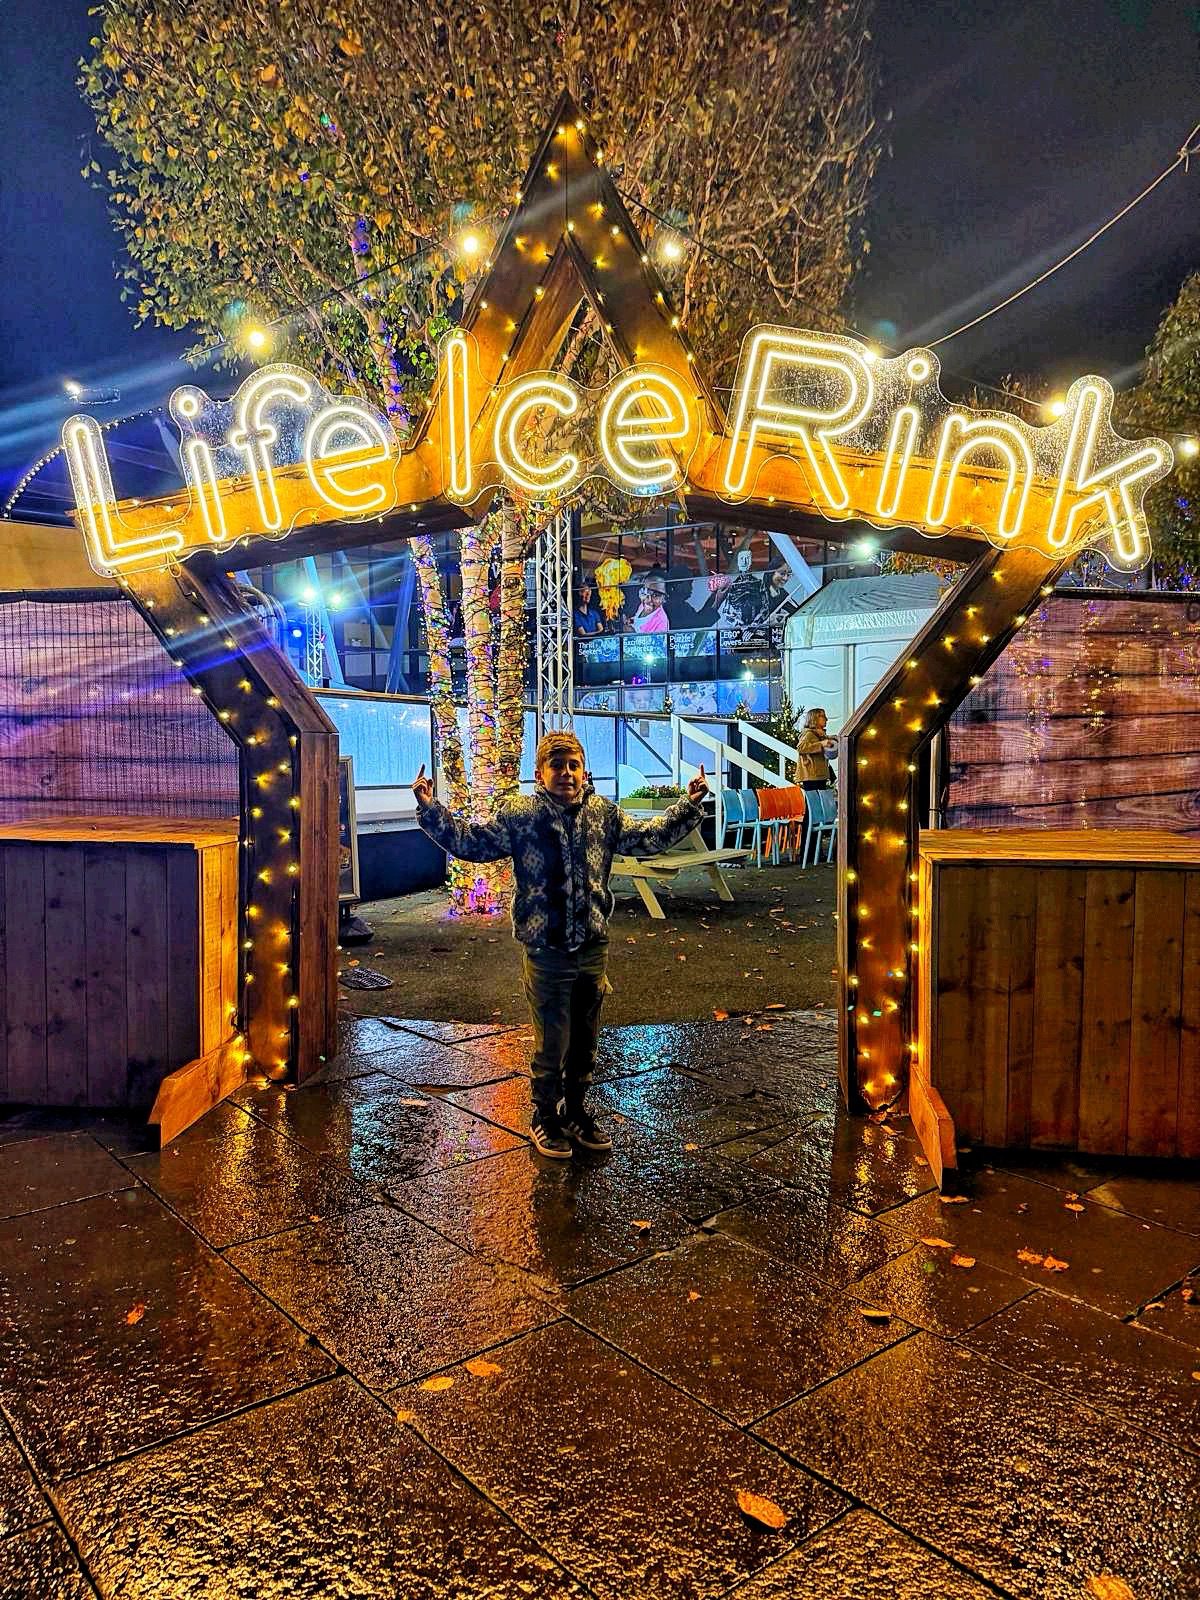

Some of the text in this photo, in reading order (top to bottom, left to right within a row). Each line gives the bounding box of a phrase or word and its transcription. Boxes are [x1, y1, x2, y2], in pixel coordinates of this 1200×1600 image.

[72, 333, 1163, 566] Life Ice Rink
[669, 642, 695, 650] Solvers
[720, 639, 742, 647] Lovers
[578, 648, 602, 656] Seekers
